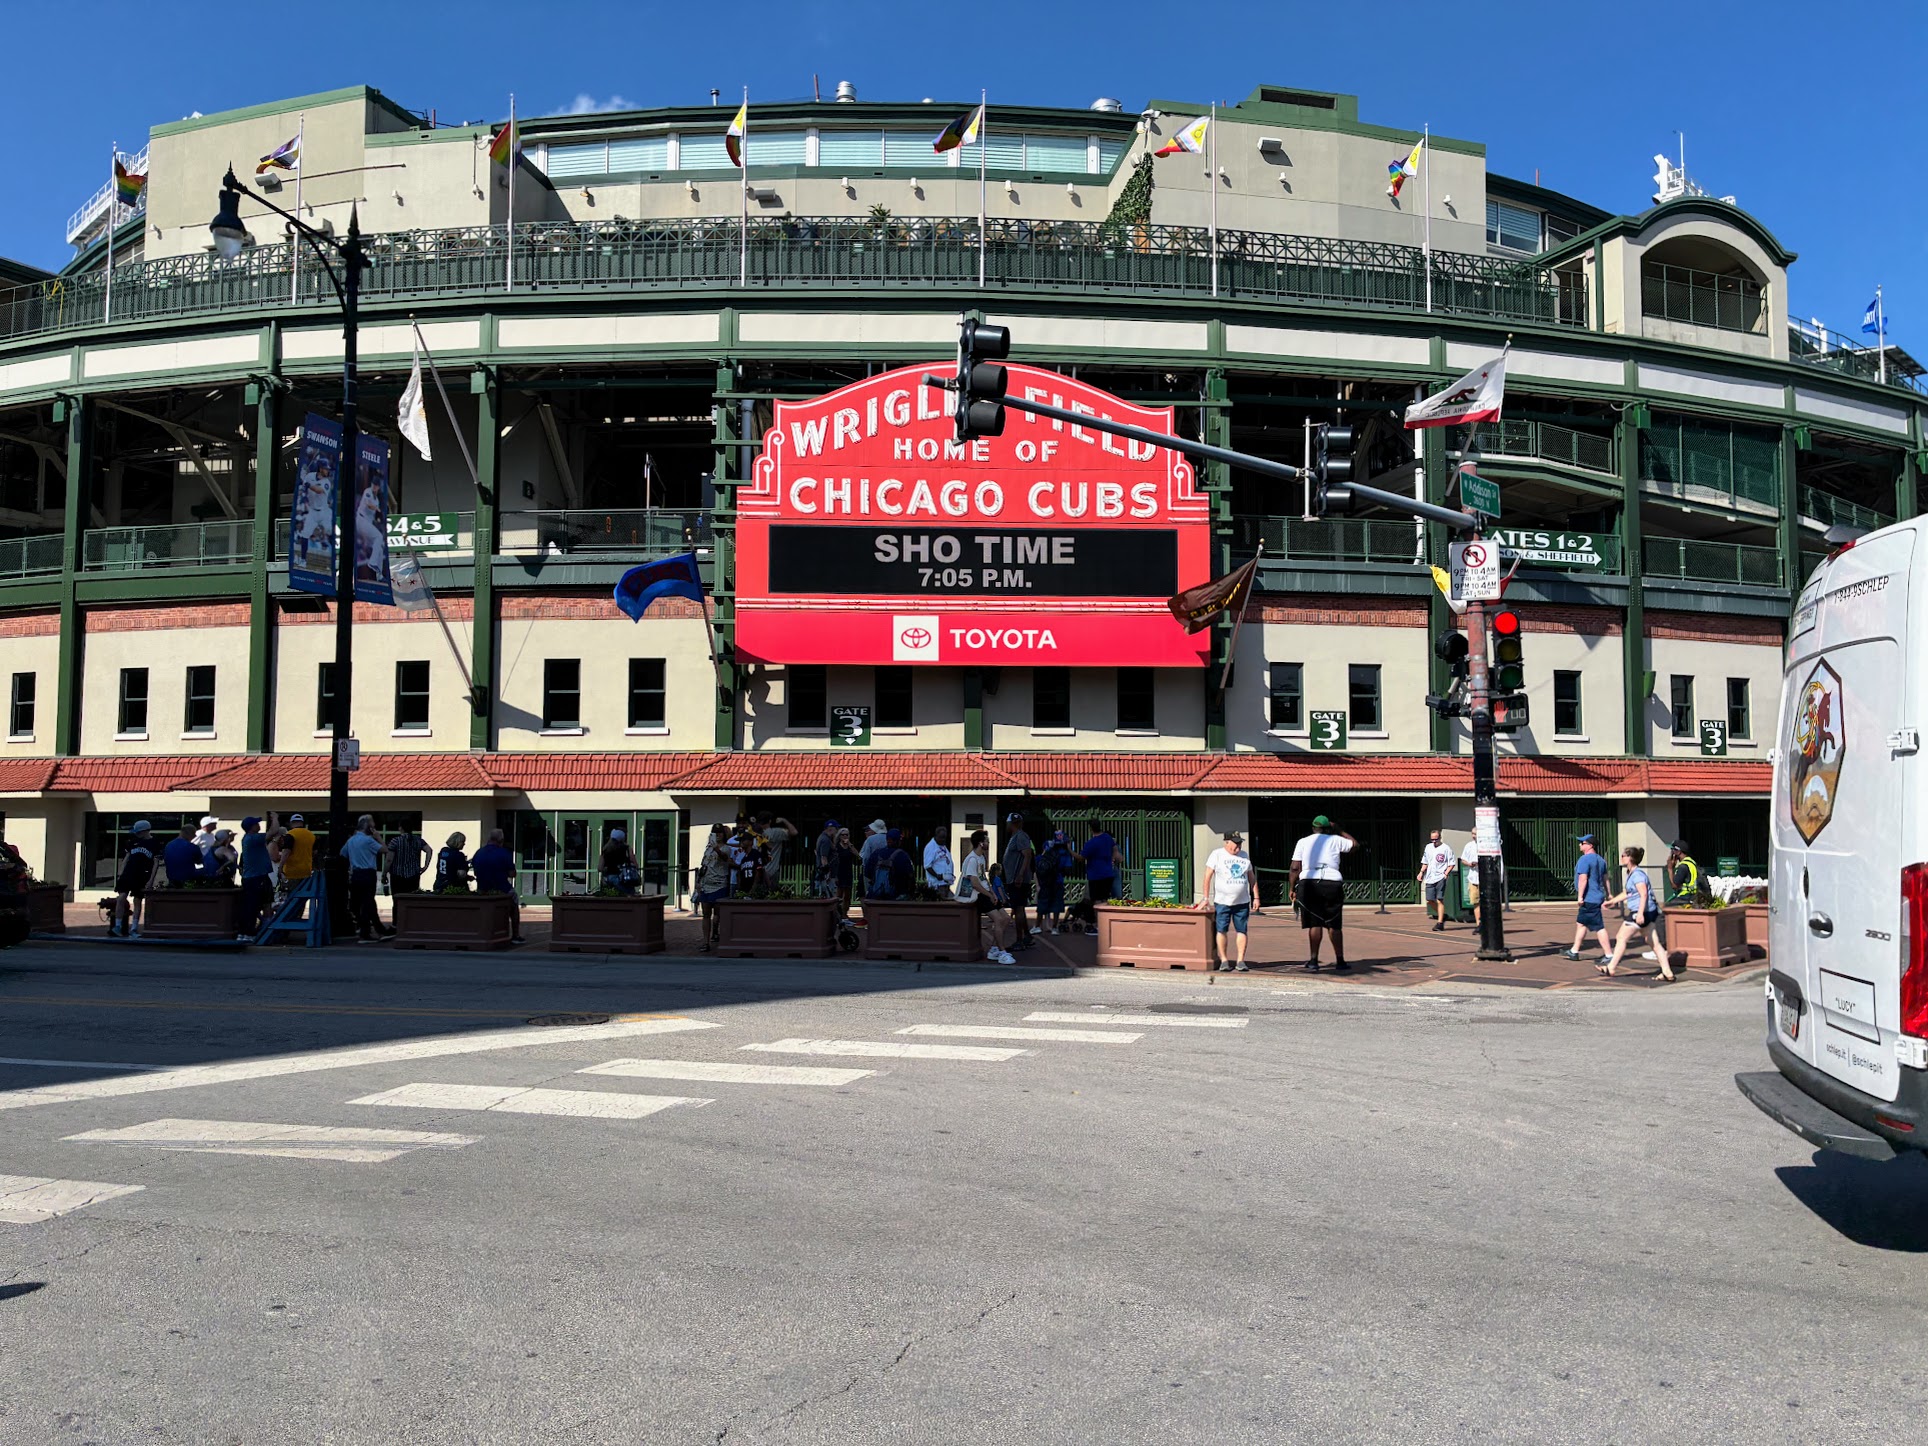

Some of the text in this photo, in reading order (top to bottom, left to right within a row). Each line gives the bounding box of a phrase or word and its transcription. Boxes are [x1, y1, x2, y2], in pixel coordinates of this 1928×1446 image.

[790, 384, 1157, 462] WRIGL FIELD
[307, 430, 338, 449] SWANSON
[361, 449, 381, 464] STEELE
[894, 438, 1060, 462] HOME OF
[789, 476, 1160, 519] CHICAGO CUBS
[1468, 479, 1492, 500] Addison
[387, 536, 435, 545] AVNUE
[1490, 529, 1550, 549] ATES
[874, 534, 1076, 565] SHO TIME
[1537, 551, 1596, 564] SHEFFIELD
[918, 568, 1033, 588] 7:05 P.M.
[950, 628, 1058, 650] TOYOTA
[833, 707, 868, 716] GATE
[1312, 712, 1344, 720] GATE
[838, 715, 863, 738] 3
[1316, 719, 1340, 742] 3
[1701, 720, 1725, 728] GATE
[1705, 727, 1723, 748] 3
